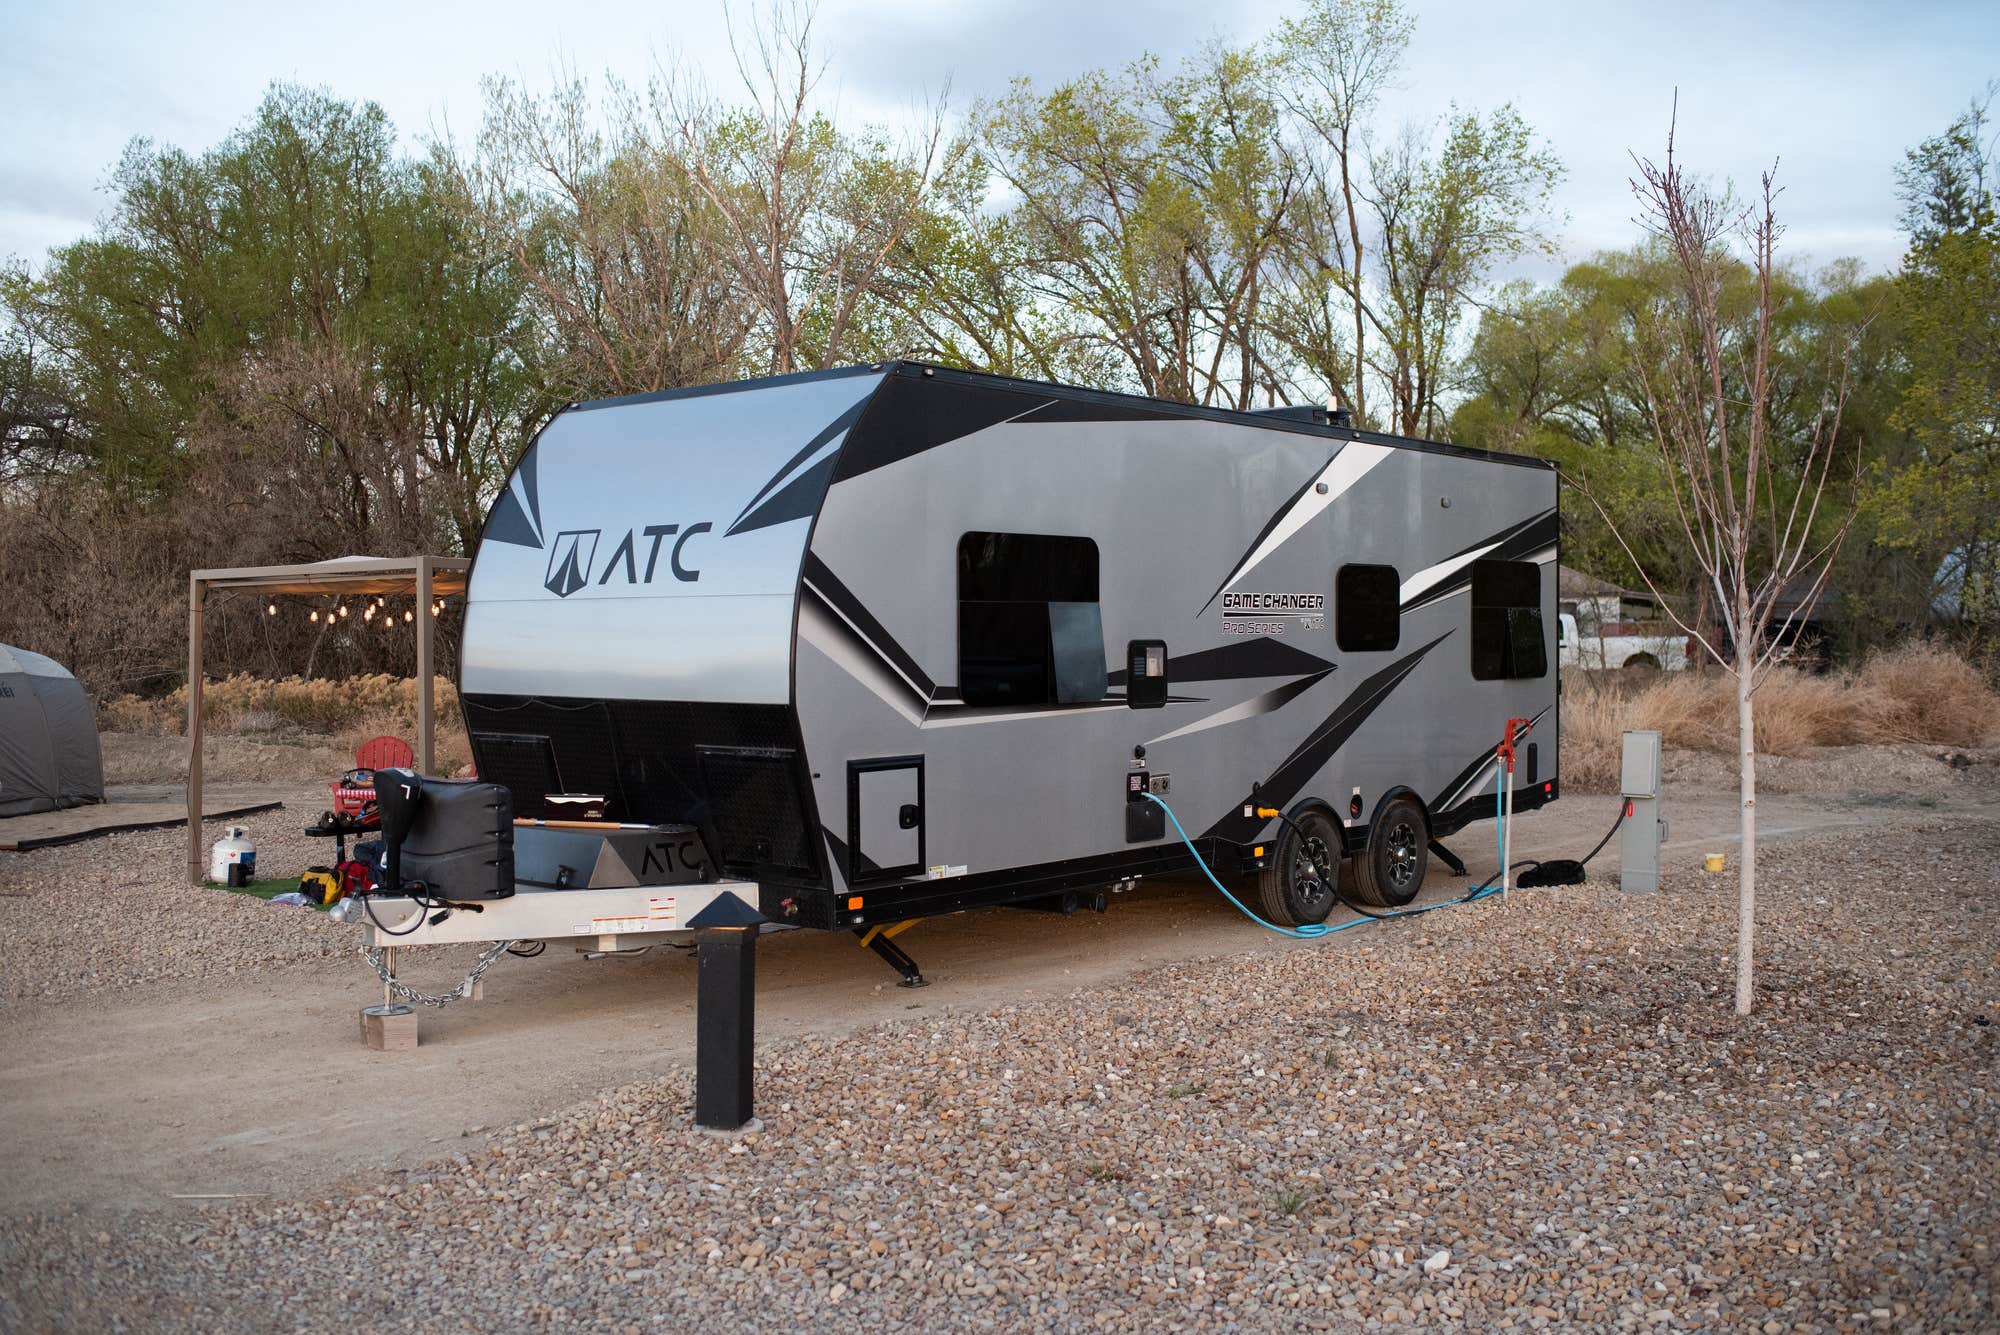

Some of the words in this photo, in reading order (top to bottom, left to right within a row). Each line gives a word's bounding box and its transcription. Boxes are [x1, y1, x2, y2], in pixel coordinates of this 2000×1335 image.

[598, 521, 713, 585] ATC
[1223, 593, 1260, 608] GAME
[1262, 594, 1324, 609] CHANGER
[641, 841, 707, 875] ATC
